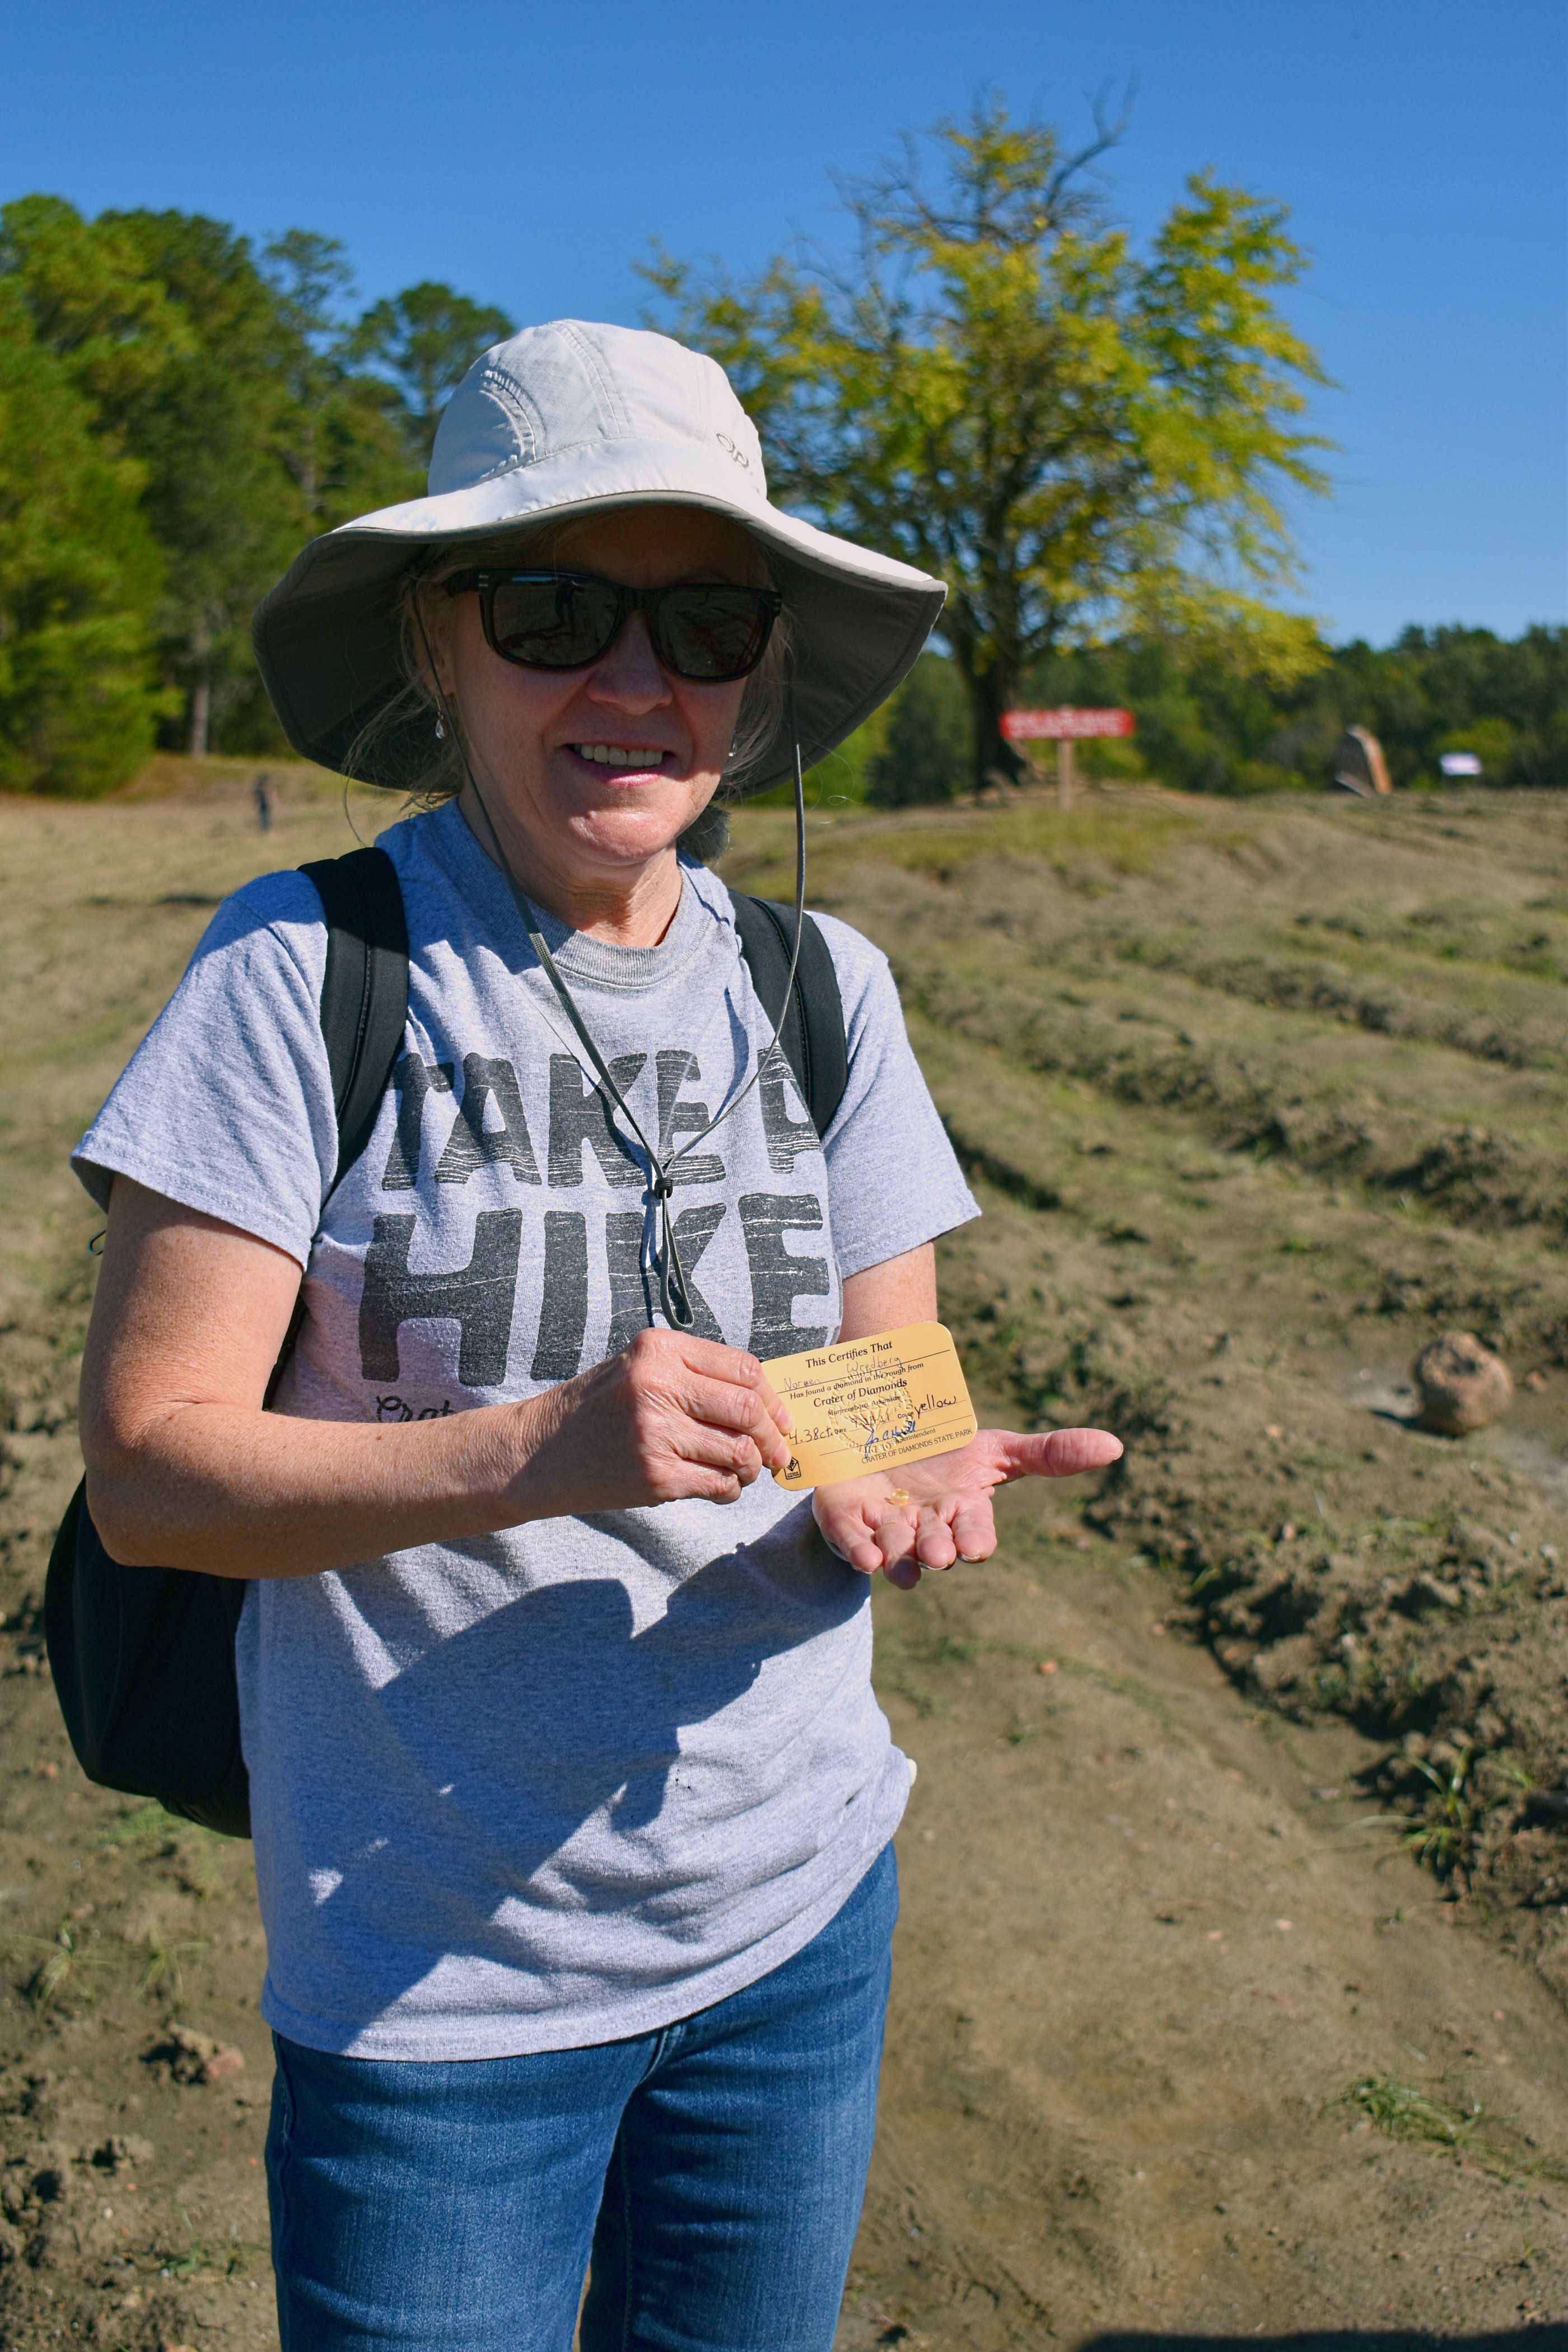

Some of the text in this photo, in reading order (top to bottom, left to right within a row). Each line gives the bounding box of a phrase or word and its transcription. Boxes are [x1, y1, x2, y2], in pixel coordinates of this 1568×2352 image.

[382, 1050, 726, 1191] TAKE
[359, 1193, 841, 1385] HIKE
[805, 1341, 893, 1368] This Certifies That
[805, 1386, 825, 1397] found
[833, 1378, 863, 1389] diamond
[874, 1371, 884, 1380] the
[885, 1368, 906, 1378] rough
[907, 1362, 923, 1373] from
[814, 1379, 907, 1407] Crater of Diamonds
[872, 1395, 901, 1406] Arkansas
[914, 1394, 956, 1420] yellow
[862, 1452, 888, 1464] CRATER
[898, 1439, 934, 1454] DIAMONDS
[934, 1432, 955, 1444] STATE
[955, 1427, 973, 1439] PARK
[892, 1429, 936, 1445] Superintendent
